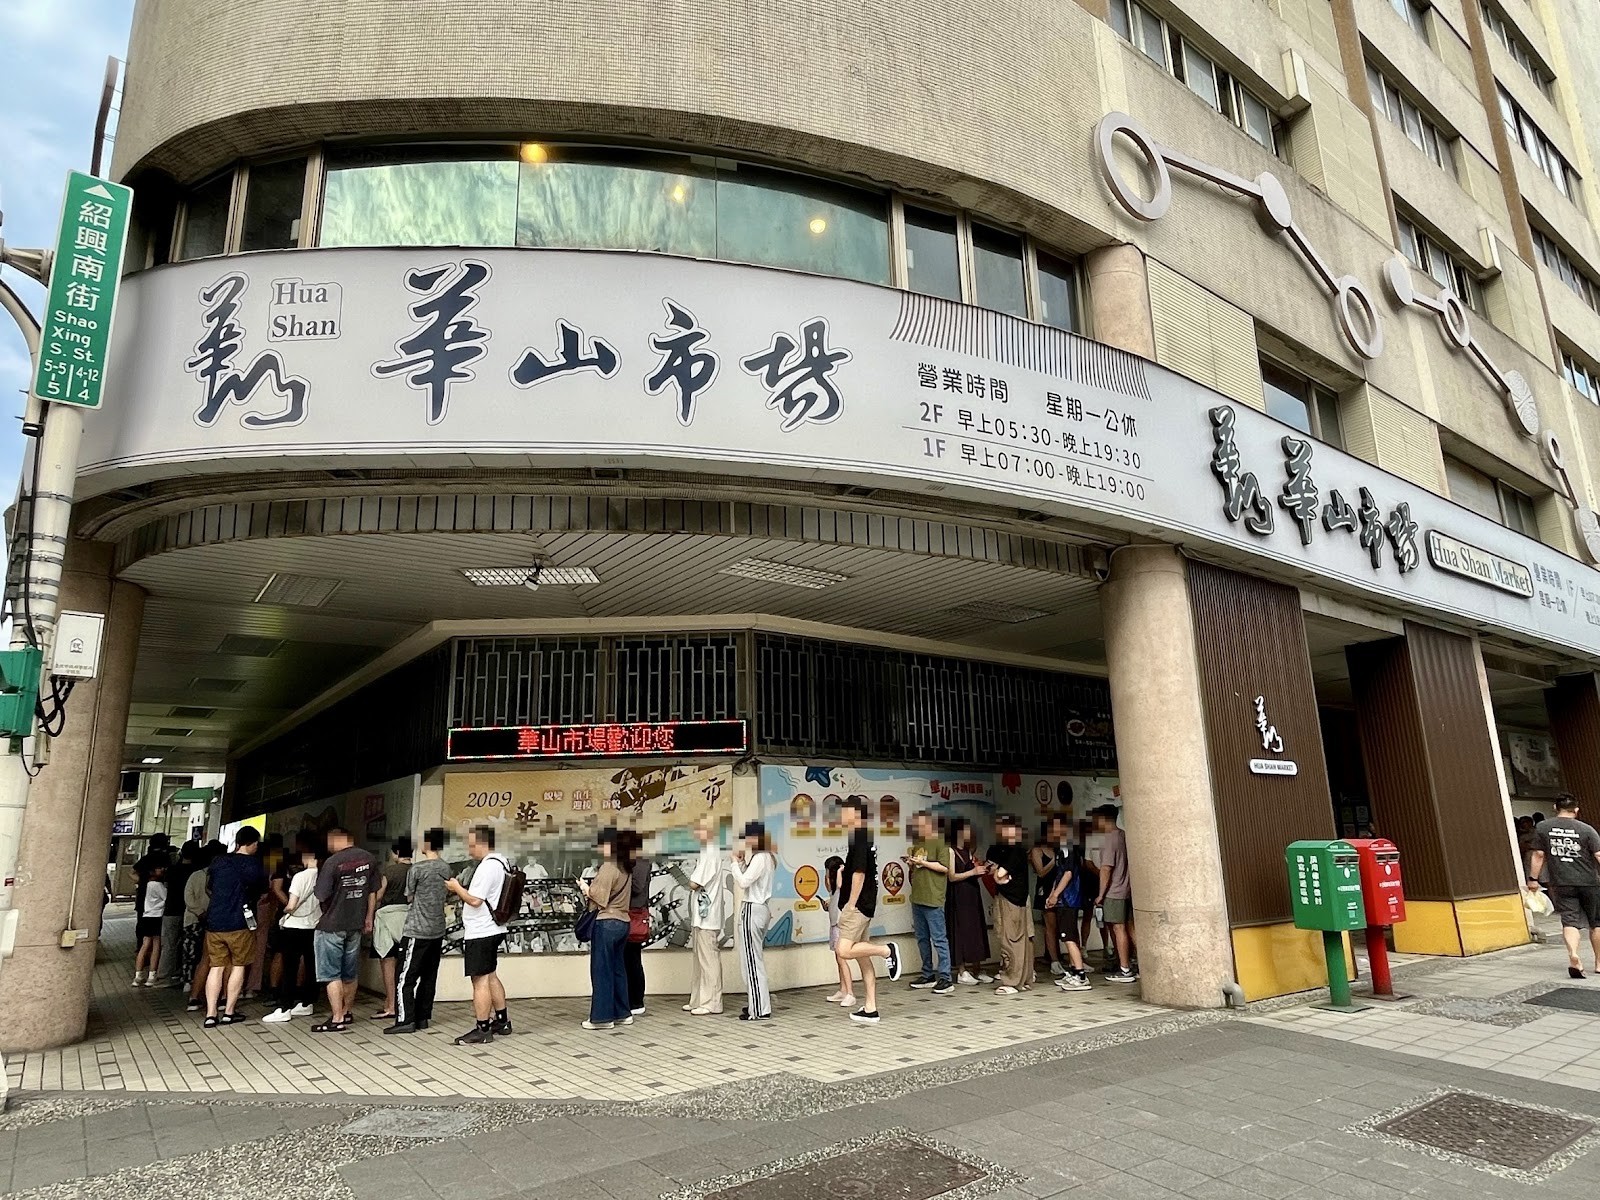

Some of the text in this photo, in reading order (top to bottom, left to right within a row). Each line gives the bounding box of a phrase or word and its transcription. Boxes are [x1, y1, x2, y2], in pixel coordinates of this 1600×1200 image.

[66, 200, 113, 312] 紹興南街
[274, 281, 329, 305] Hua
[54, 310, 98, 330] Shao
[271, 314, 337, 338] Shan
[51, 326, 91, 348] Xing
[374, 263, 851, 430] 華山市場
[50, 343, 95, 363] S. St.
[44, 360, 67, 375] 5-5
[75, 366, 99, 382] 4-12
[47, 381, 60, 395] 5
[78, 388, 90, 401] 4
[917, 362, 1138, 438] 營業時間 星期一公休
[919, 401, 1142, 470] 2F 早上05:30-晚上19:30
[923, 437, 1146, 501] 1F 早上07:00-晚上19:00
[1278, 436, 1420, 573] 華山市場
[1431, 535, 1532, 594] Hua Shan Market
[517, 726, 675, 754] 華山市場歡迎您
[464, 791, 513, 808] 2009
